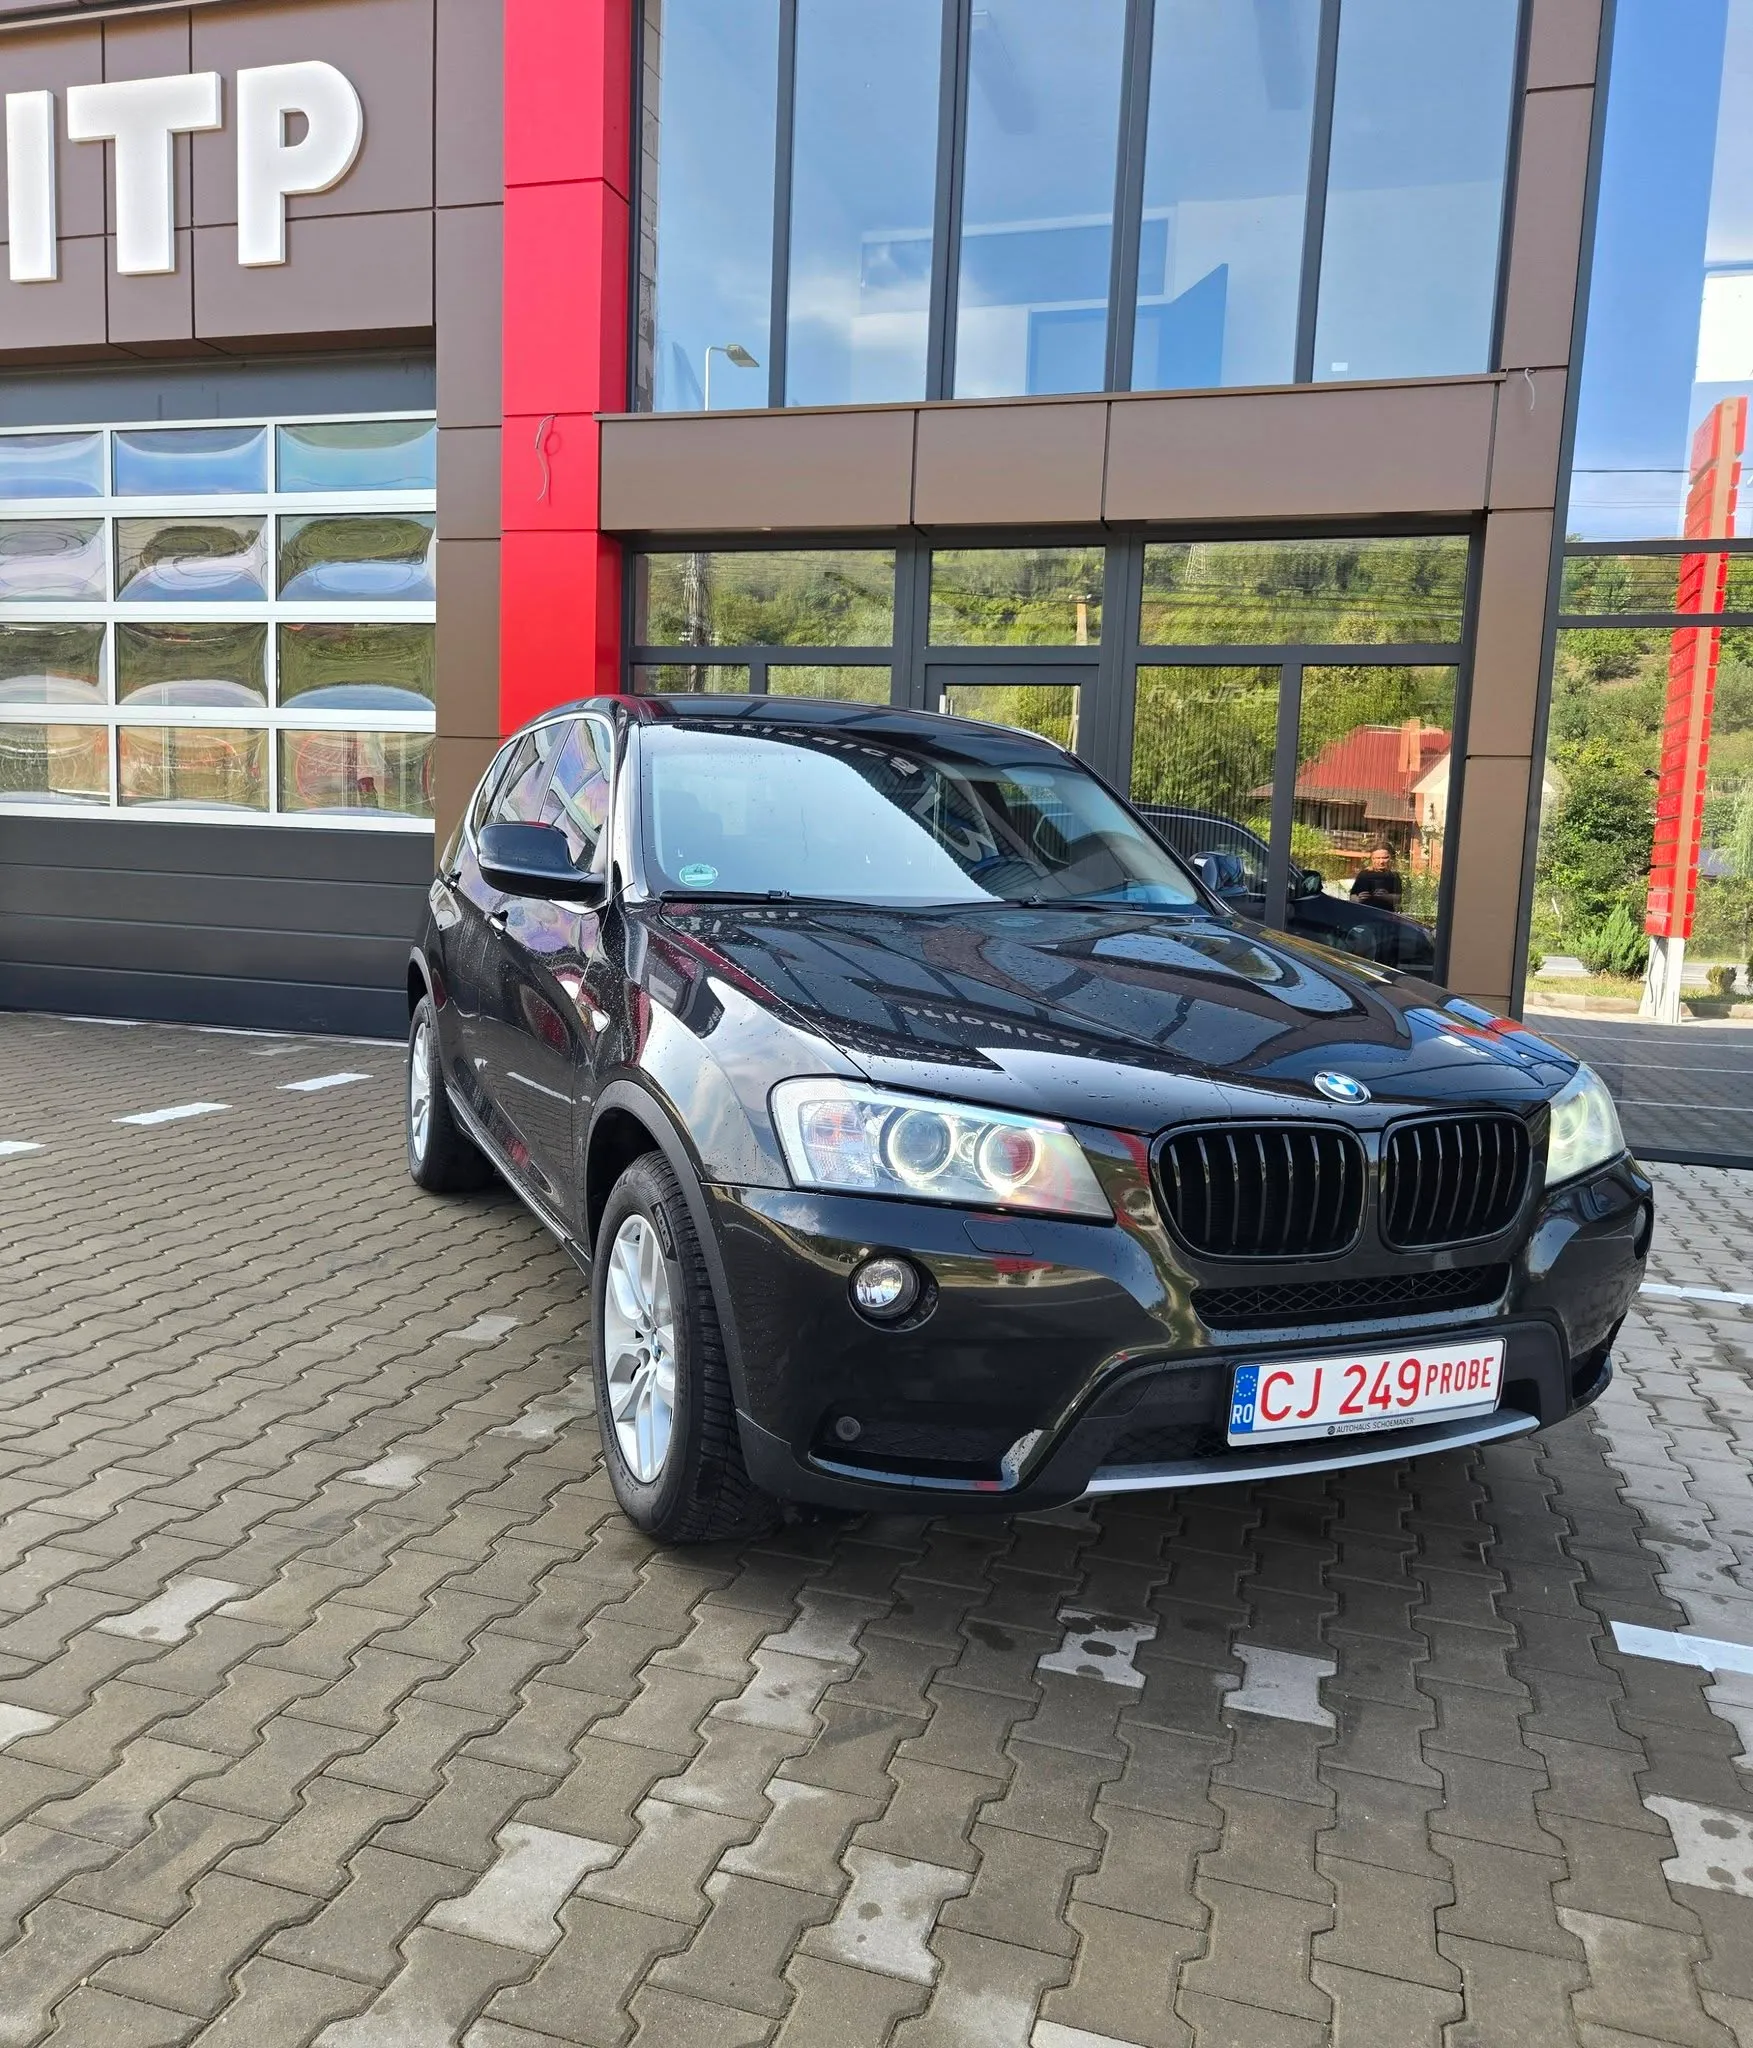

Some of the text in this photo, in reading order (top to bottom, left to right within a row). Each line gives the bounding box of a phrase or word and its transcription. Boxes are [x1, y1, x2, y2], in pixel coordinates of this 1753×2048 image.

[5, 60, 364, 284] ITP
[1260, 1356, 1495, 1421] CJ 249 PROBE
[1232, 1403, 1253, 1425] RO
[1336, 1416, 1415, 1434] AUTOHAUS SCHOEMAKER
